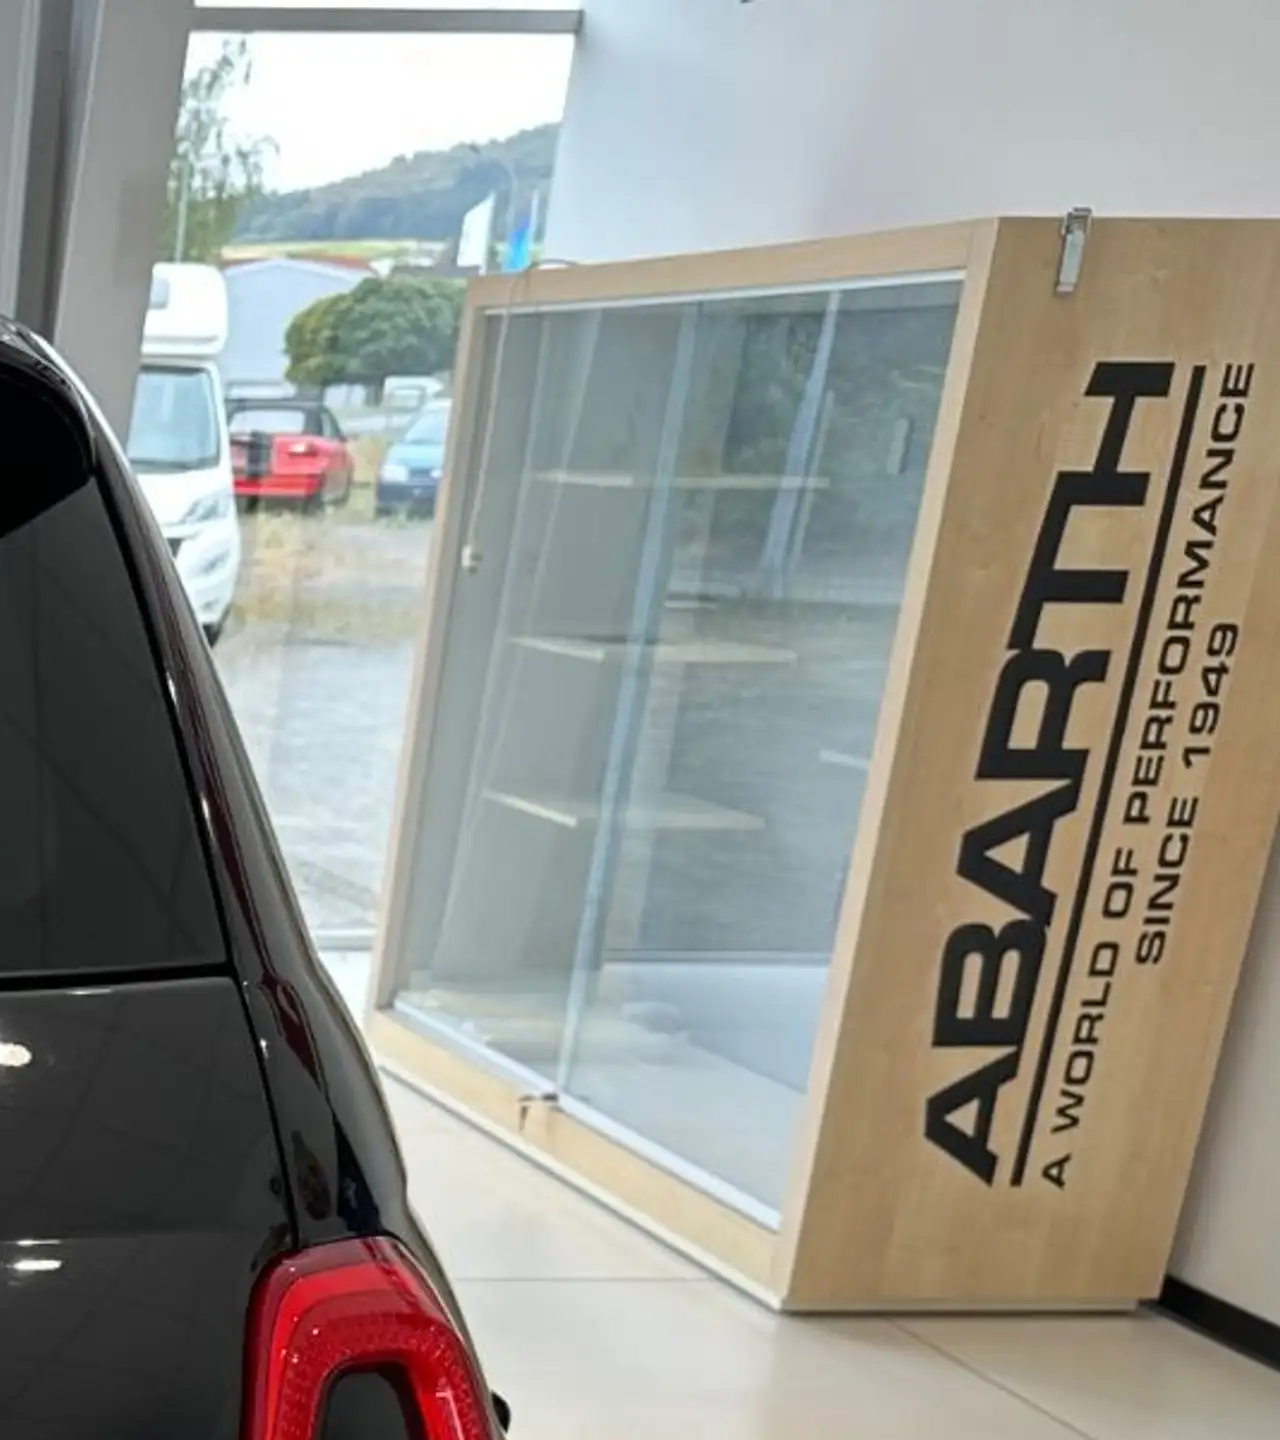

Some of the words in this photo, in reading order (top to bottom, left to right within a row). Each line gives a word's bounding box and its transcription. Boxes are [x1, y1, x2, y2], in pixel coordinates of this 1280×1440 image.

[1123, 362, 1256, 826] PERFORMANCE
[924, 361, 1177, 1188] ABARTH
[1102, 847, 1139, 919] OF
[1135, 796, 1200, 965] SINCE
[1181, 621, 1239, 769] 1949
[1042, 1152, 1073, 1190] A
[1051, 941, 1121, 1134] WORLD
